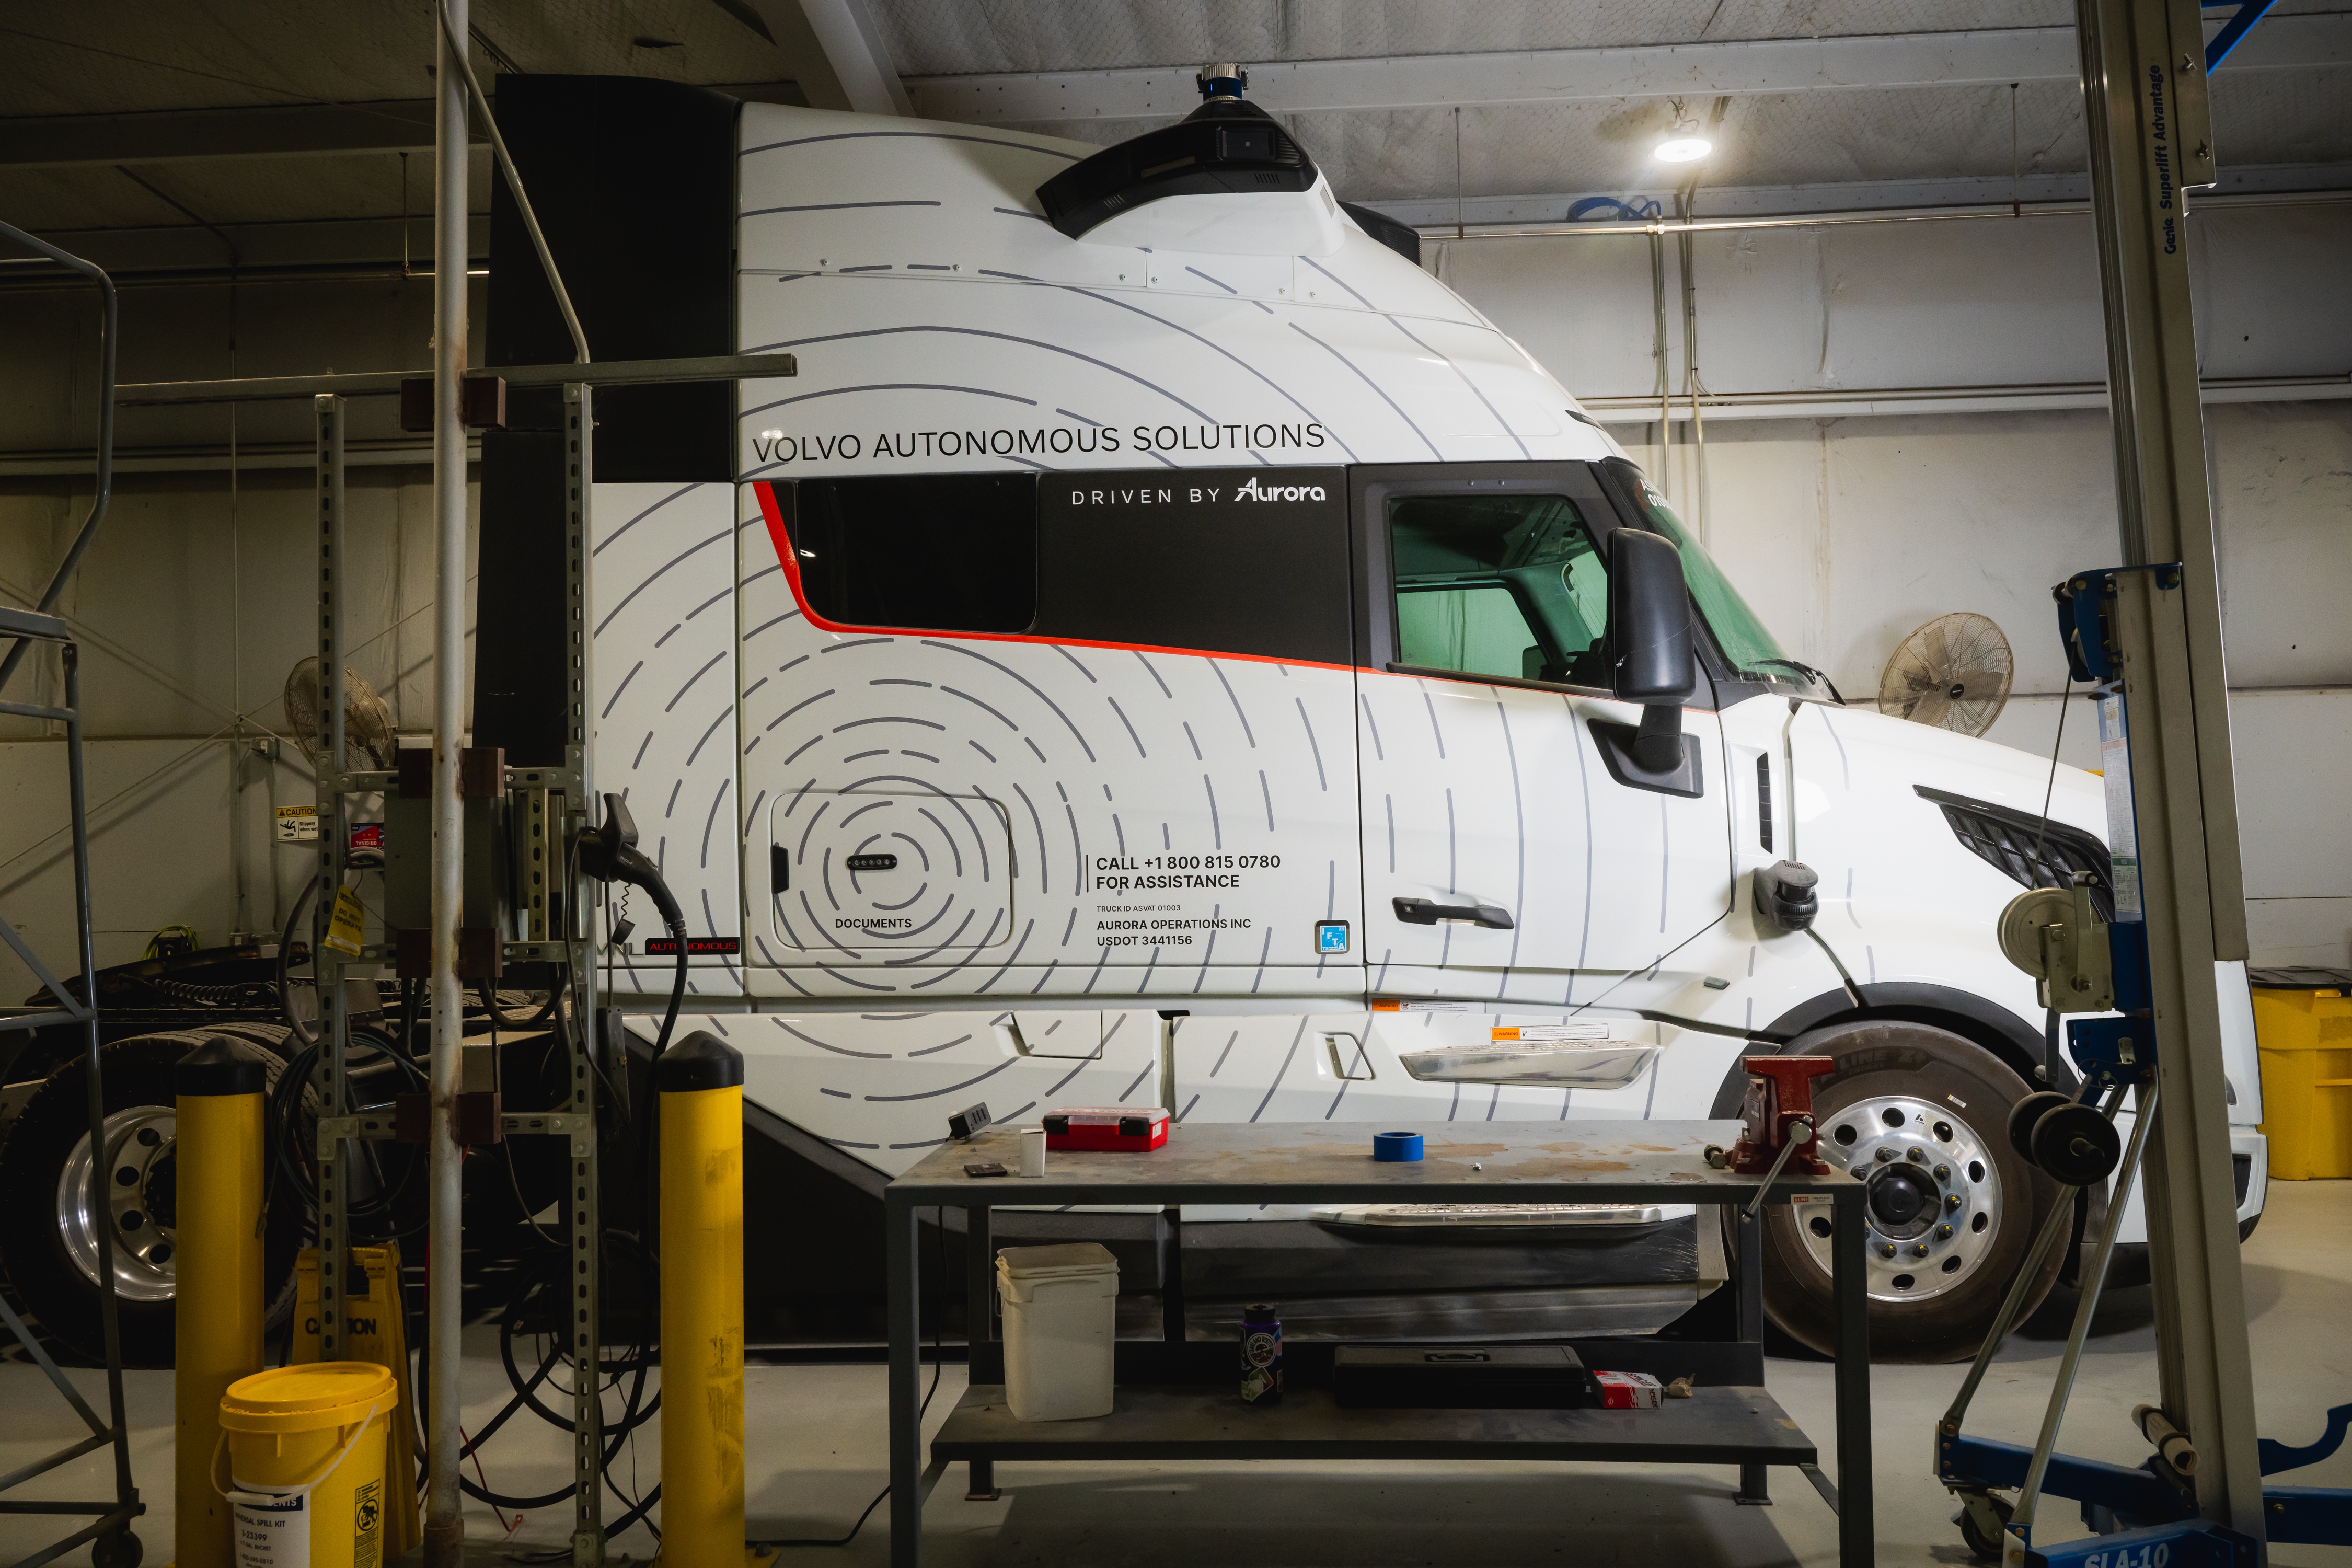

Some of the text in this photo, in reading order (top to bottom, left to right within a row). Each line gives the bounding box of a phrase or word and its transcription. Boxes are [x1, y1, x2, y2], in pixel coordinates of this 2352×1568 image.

[2149, 64, 2176, 255] Genie Superlift Advantage
[753, 424, 1324, 463] VOLVO AUTONOMOUS SOLUTIONS
[1073, 477, 1325, 504] DRIVEN BY Aurora
[1097, 855, 1281, 870] CALL +1 800 815 0780
[1097, 875, 1239, 889] FOR ASSISTANCE
[335, 915, 362, 932] OPERATE
[339, 908, 361, 924] DO NOT
[836, 919, 912, 928] DOCUMENTS
[1097, 919, 1251, 930] AURORA OPERATIONS INC
[1097, 936, 1192, 946] USDOT 3441156
[305, 1317, 376, 1335] CION
[1249, 1336, 1274, 1353] OAKLAND ROOTS
[1625, 1373, 1657, 1387] SPICER
[1650, 1389, 1658, 1408] SPICER
[242, 1529, 267, 1541] S-23399
